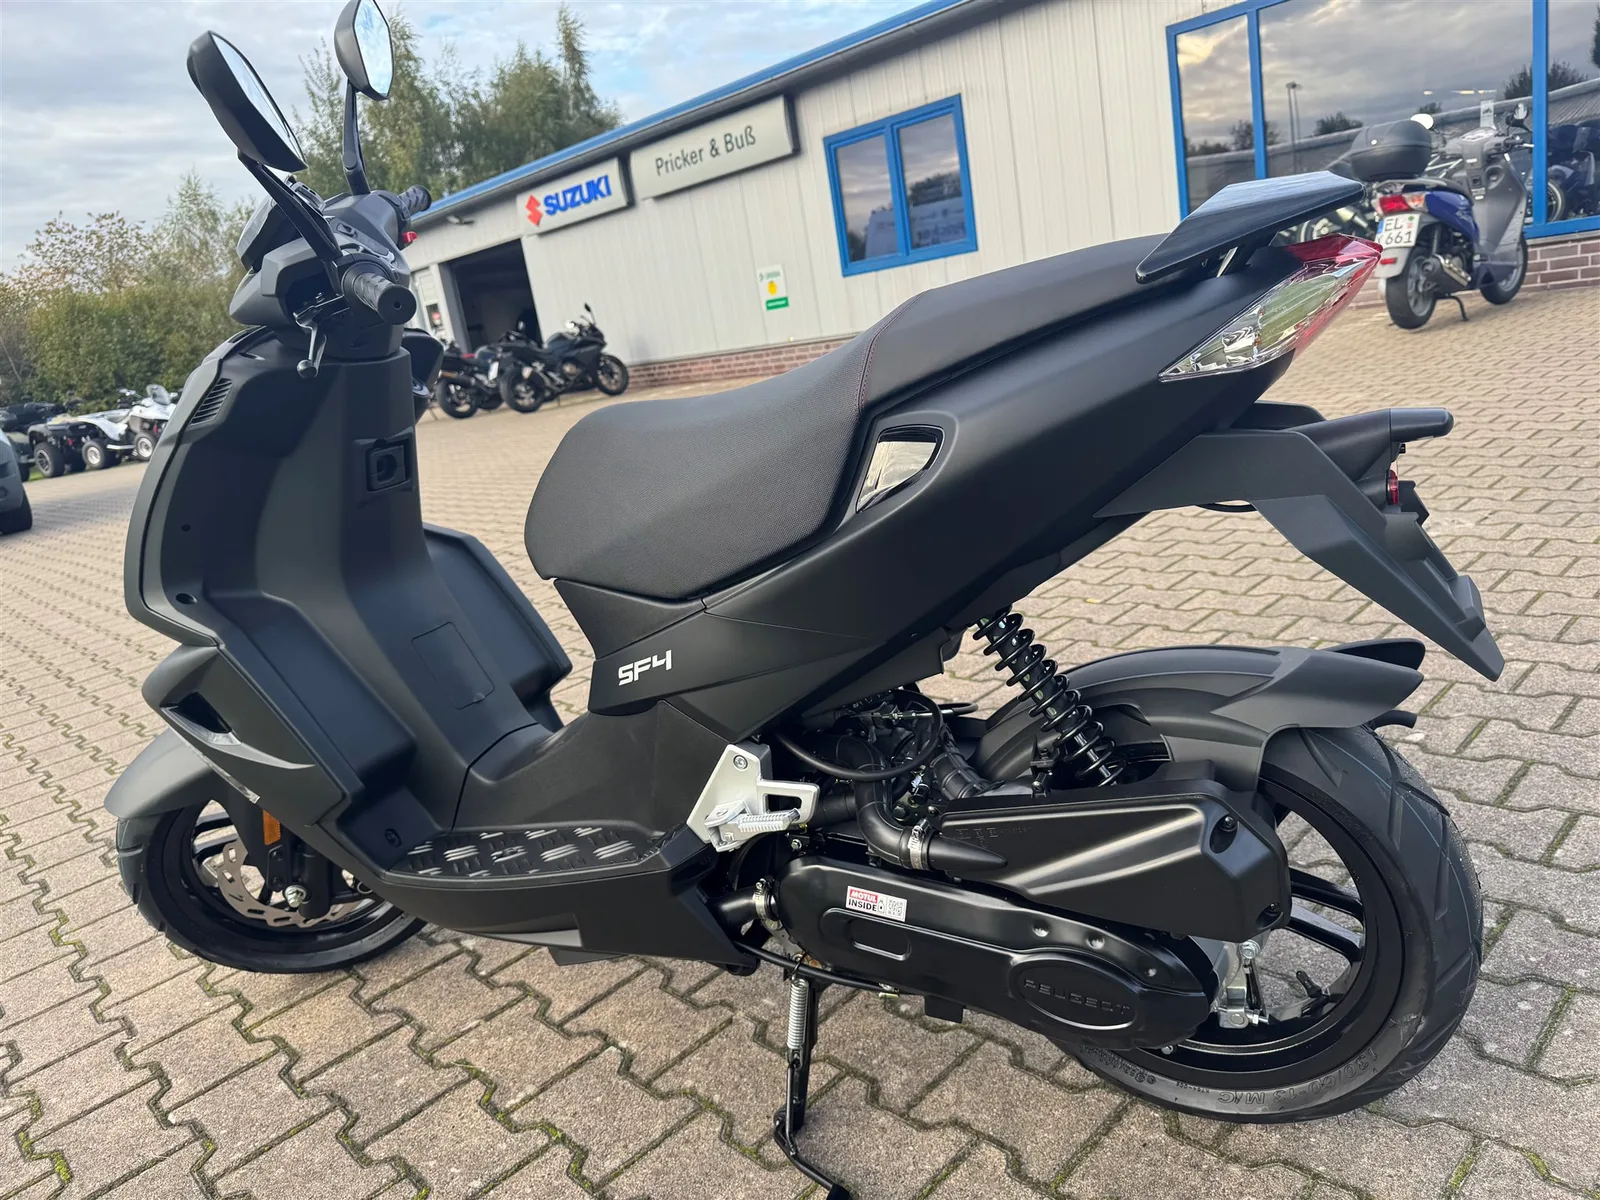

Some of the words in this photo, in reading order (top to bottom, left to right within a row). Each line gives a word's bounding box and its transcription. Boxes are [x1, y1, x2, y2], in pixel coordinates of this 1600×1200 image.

[655, 147, 704, 176] Pricker
[709, 138, 721, 158] &
[723, 125, 757, 154] Buß
[543, 175, 612, 216] SUZUKI
[1384, 217, 1404, 232] EL
[618, 649, 672, 686] SF4
[847, 898, 878, 912] INSIDE
[850, 889, 877, 903] MOTUL
[1023, 976, 1131, 1015] PEUGEOT
